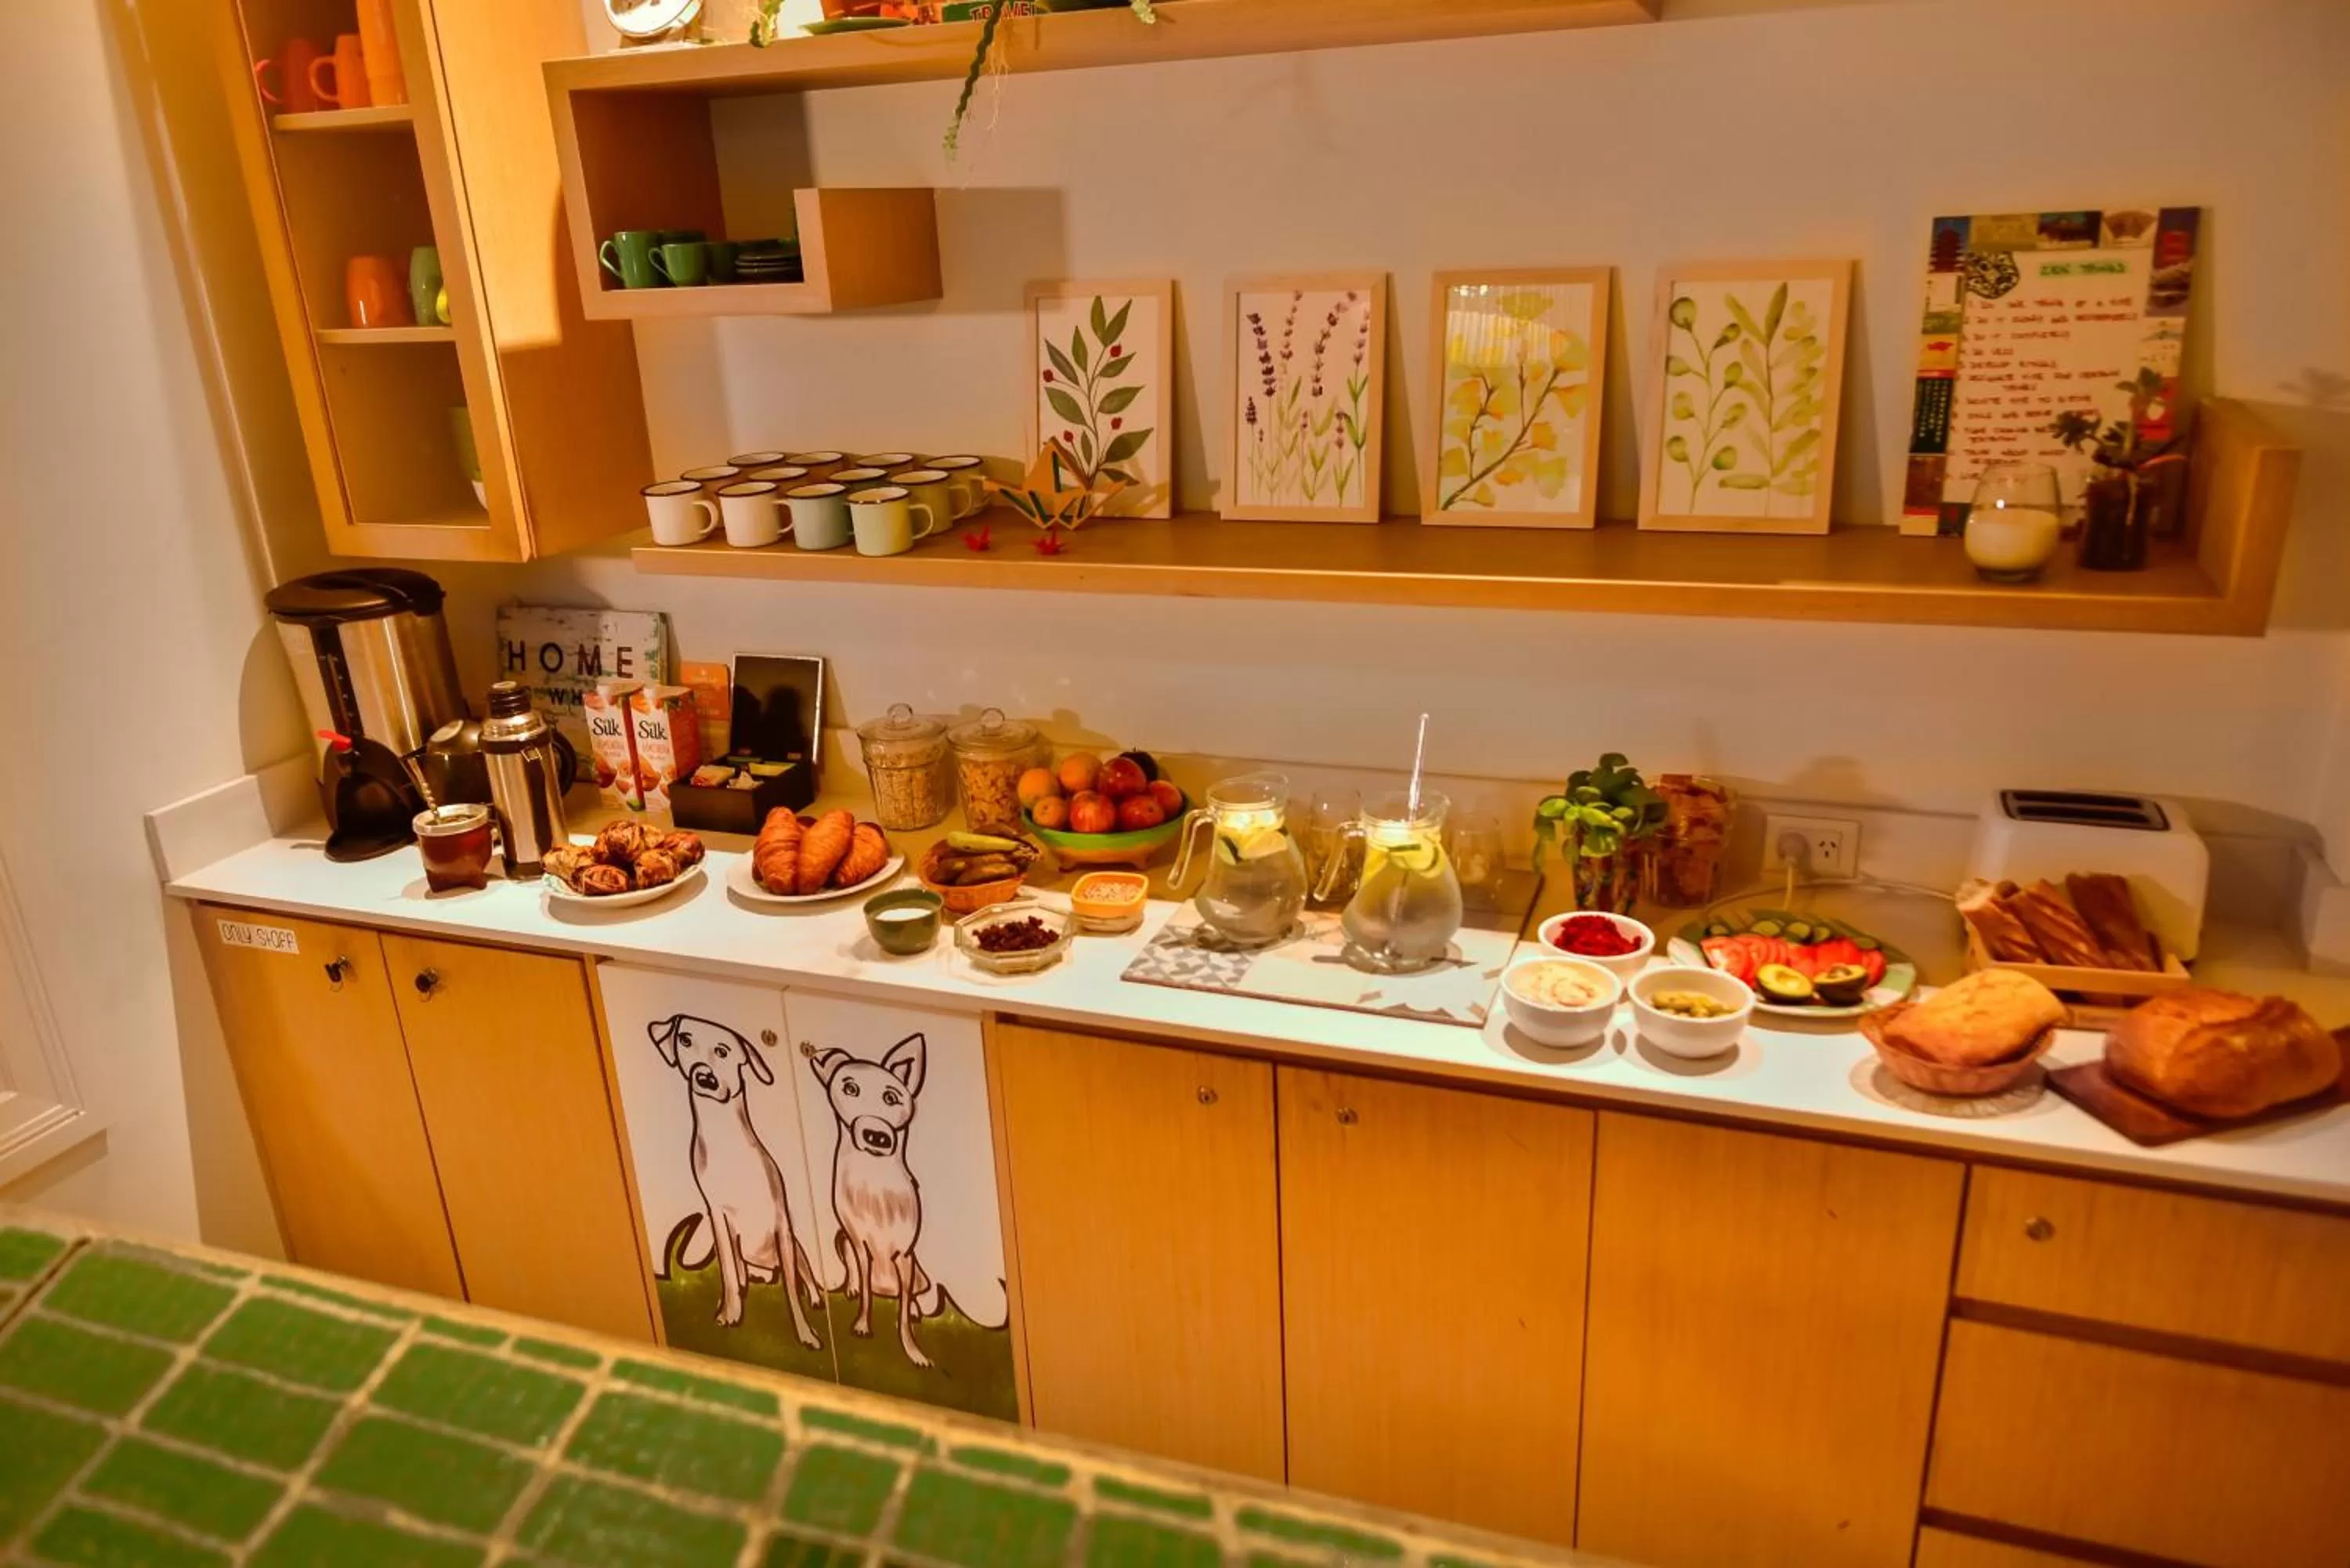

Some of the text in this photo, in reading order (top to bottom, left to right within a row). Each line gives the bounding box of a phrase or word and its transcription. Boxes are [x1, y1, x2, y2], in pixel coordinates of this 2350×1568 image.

[507, 640, 634, 679] HOME
[592, 717, 623, 737] Silk
[638, 720, 668, 740] Silk
